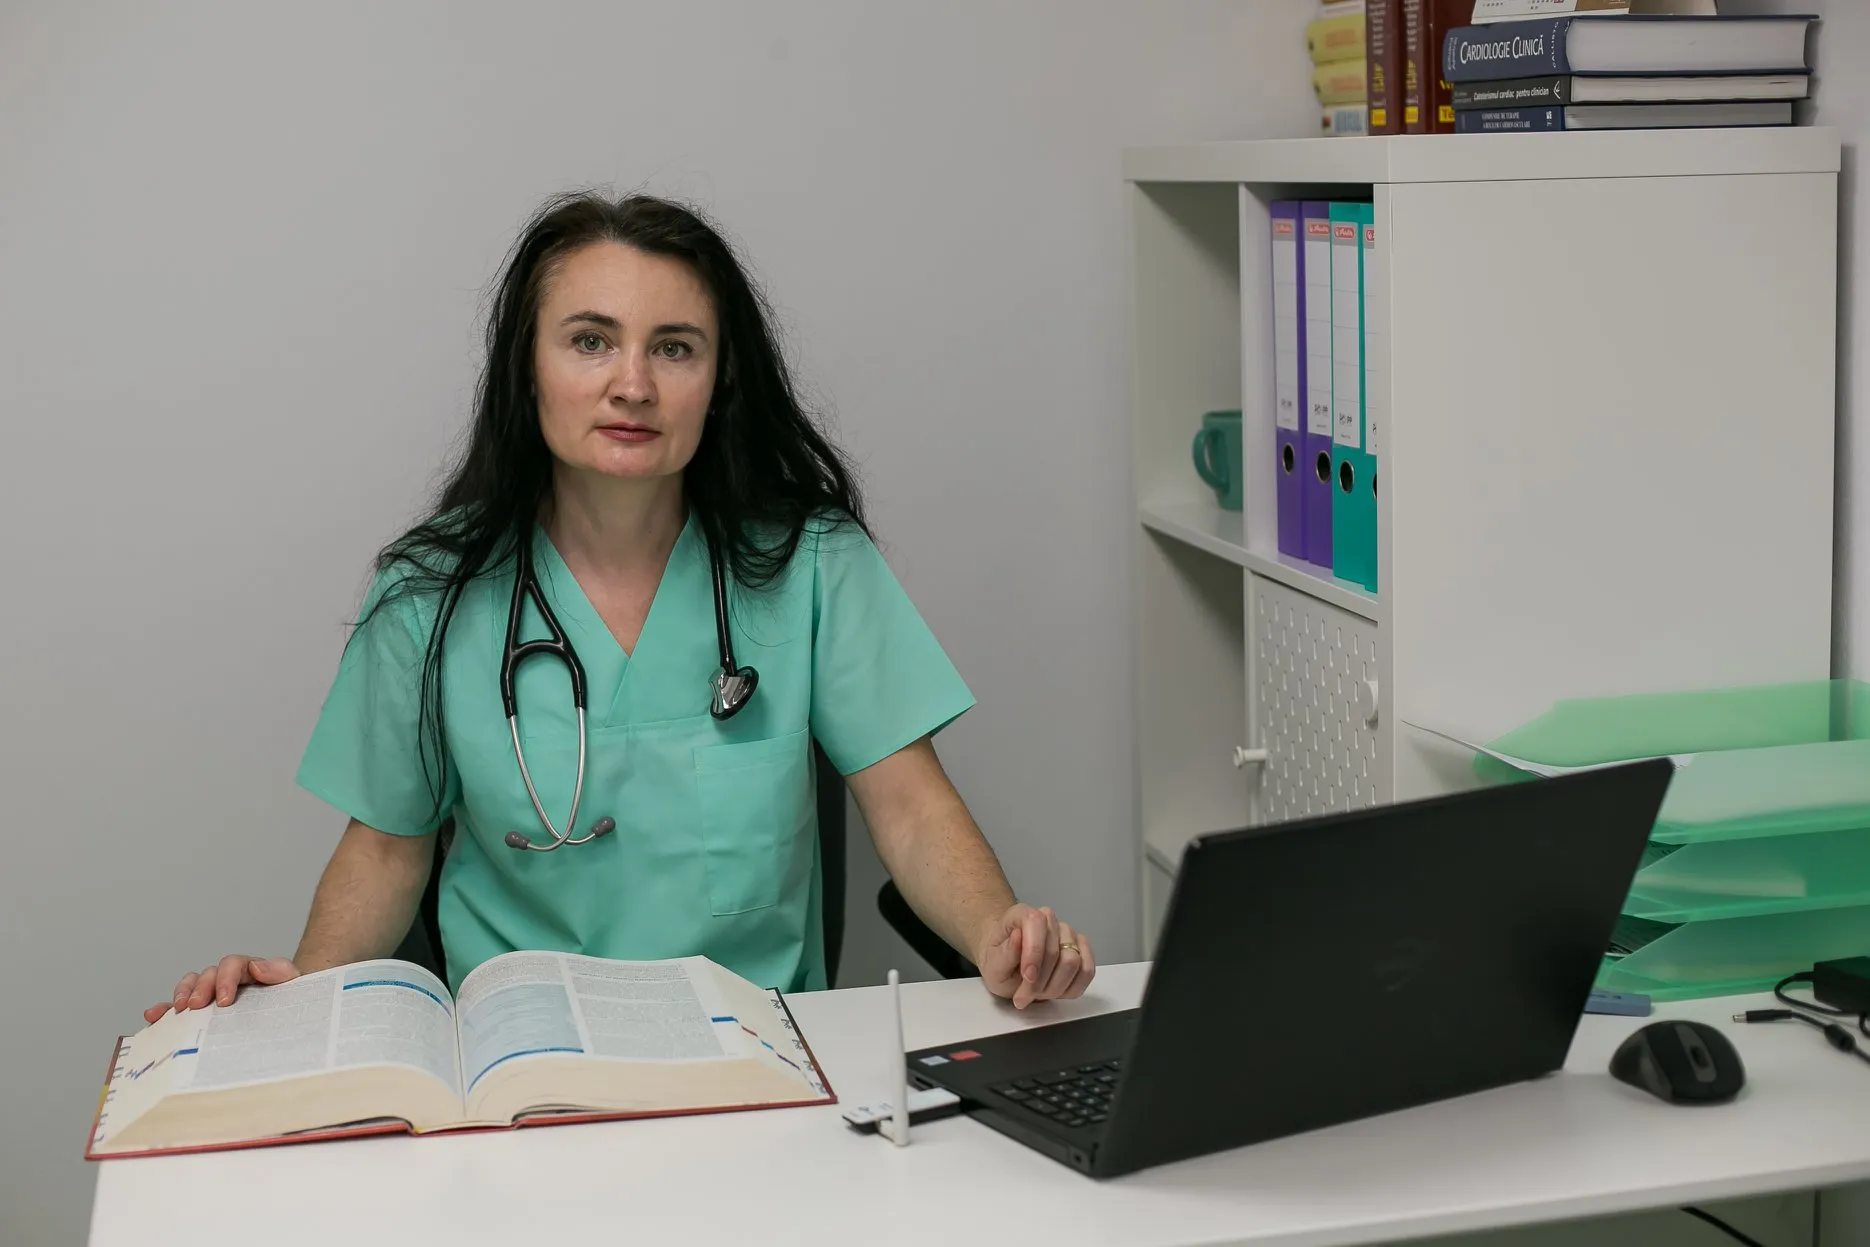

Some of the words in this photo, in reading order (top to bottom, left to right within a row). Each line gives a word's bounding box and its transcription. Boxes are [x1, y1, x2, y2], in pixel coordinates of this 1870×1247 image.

[1460, 41, 1511, 64] CARDIOLOGIE
[1499, 89, 1515, 99] cardiac
[1516, 89, 1531, 100] pentru
[1531, 86, 1549, 97] clinician
